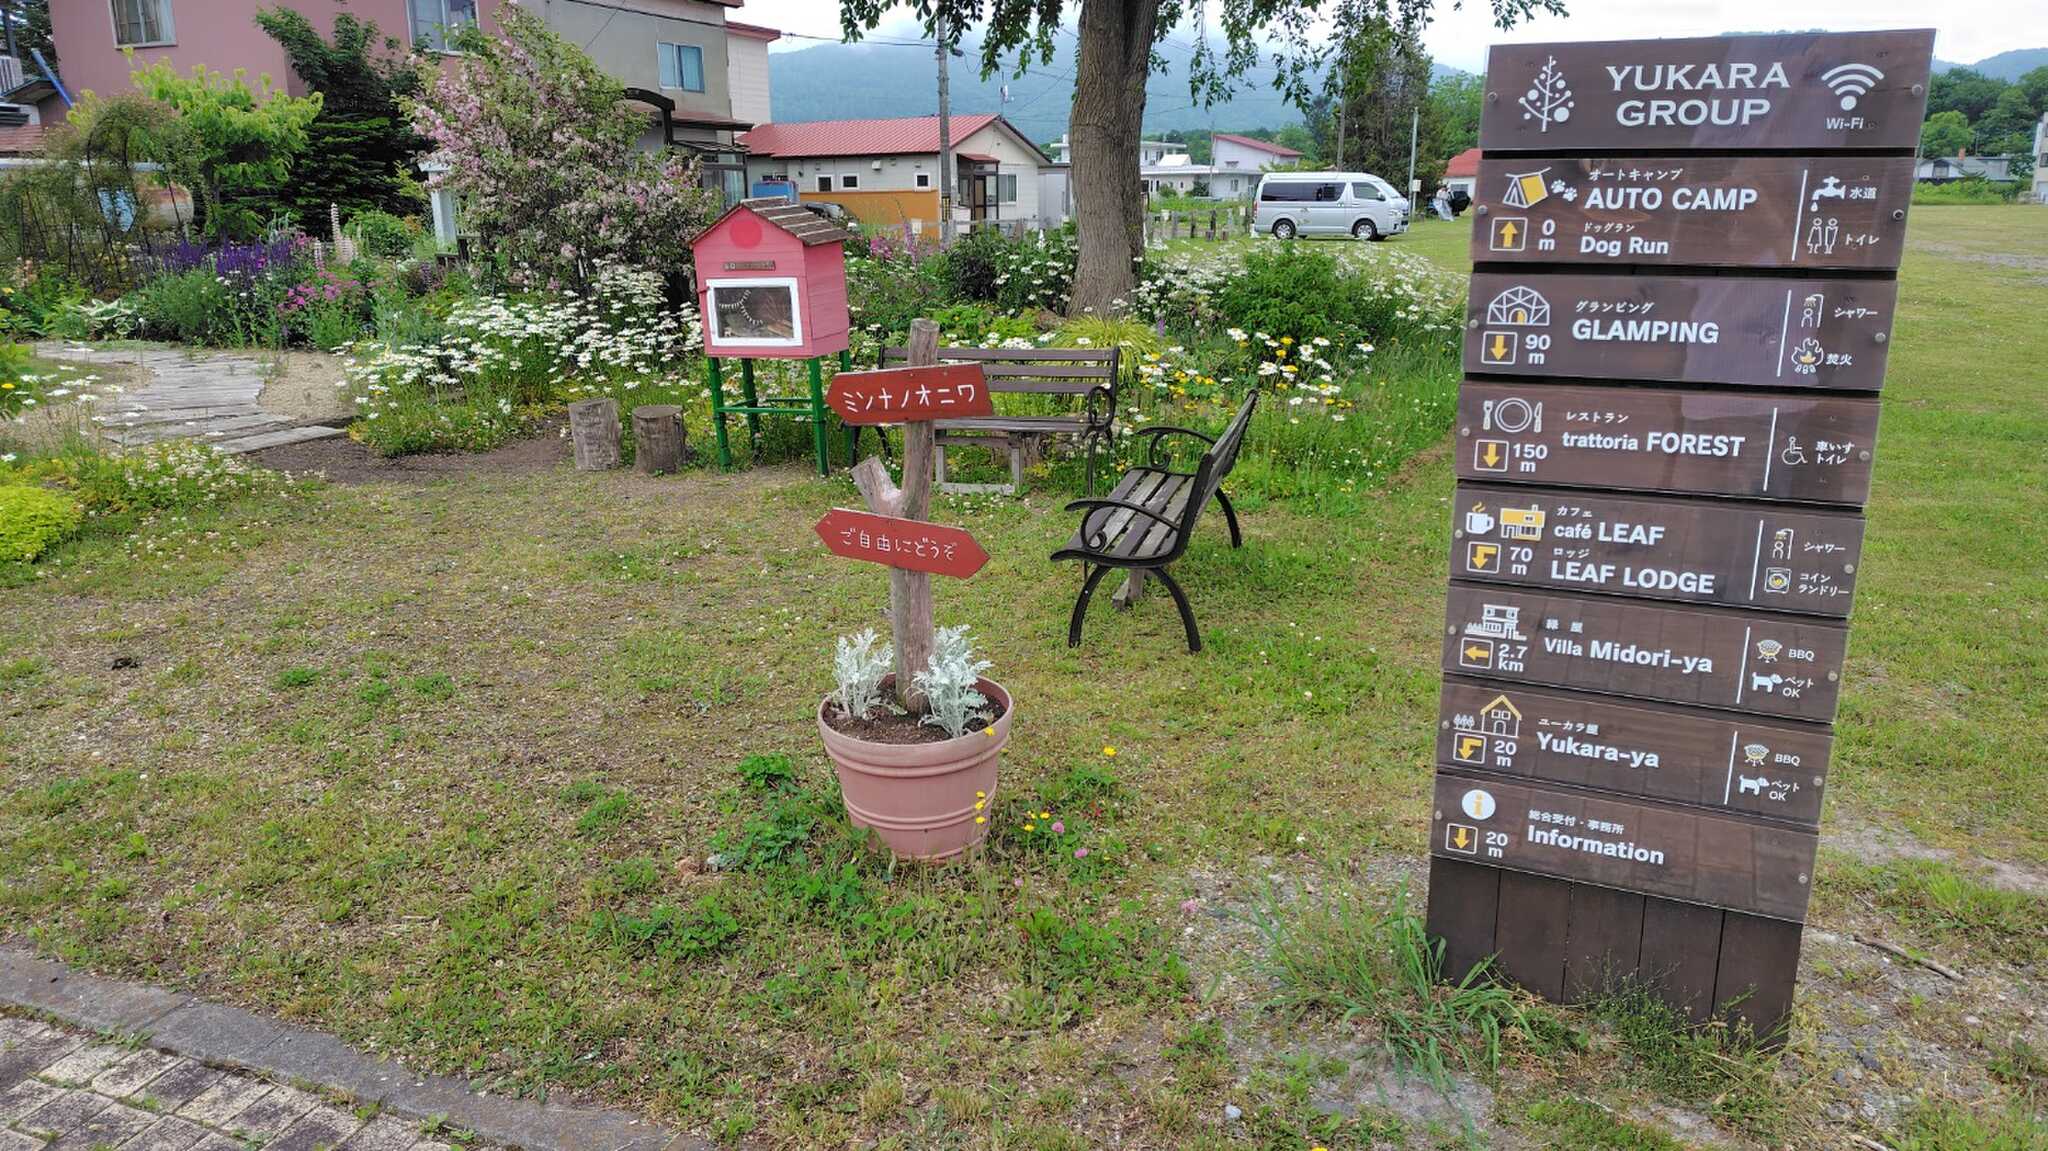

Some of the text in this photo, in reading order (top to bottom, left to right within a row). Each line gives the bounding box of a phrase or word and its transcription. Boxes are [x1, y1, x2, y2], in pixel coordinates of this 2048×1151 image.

[1604, 61, 1791, 92] YUKARA
[1615, 98, 1772, 128] GROUP
[1825, 116, 1864, 131] Wi-Fi
[1588, 167, 1685, 181] オートキャンプ
[1583, 188, 1759, 212] AUTO CAMP
[1849, 185, 1878, 200] 水道
[1582, 221, 1636, 234] ドッグラン
[1538, 236, 1556, 252] m
[1579, 234, 1670, 258] Dog Run
[1844, 232, 1880, 247] トイレ
[1574, 299, 1656, 315] グランピング
[1833, 305, 1880, 319] シャワー
[1572, 317, 1720, 345] GLAMPING
[1524, 332, 1552, 352] 90
[1527, 351, 1546, 366] m
[1825, 351, 1853, 367] 焚火
[842, 383, 976, 413] ミンナノオニワ
[1565, 410, 1629, 425] レストラン
[1512, 442, 1549, 460] 150
[1562, 430, 1746, 458] trattoria FOREST
[1519, 459, 1537, 474] m
[1815, 451, 1847, 467] トイレ
[1556, 505, 1594, 518] カフェ
[1554, 521, 1666, 547] café LEAF
[839, 526, 958, 560] ご自由にどうぞ
[1803, 541, 1847, 554] シャワー
[1509, 546, 1534, 563] 70
[1552, 547, 1591, 560] ロッジ
[1510, 562, 1529, 577] m
[1798, 571, 1832, 584] コイン
[1550, 561, 1716, 595] LEAF LODGE
[1797, 583, 1850, 597] ランドリー
[1497, 642, 1529, 659] 2.7
[1543, 636, 1713, 675] Villa Midori-ya
[1787, 648, 1815, 663] BBQ
[1497, 656, 1524, 673] km
[1784, 675, 1815, 689] ペット
[1781, 686, 1801, 699] OK
[1493, 739, 1518, 756] 20
[1535, 731, 1661, 770] Yukara-ya
[1495, 754, 1513, 769] m
[1774, 754, 1801, 767] BBQ
[1771, 779, 1801, 792] ペット
[1768, 790, 1787, 801] OK
[1485, 831, 1509, 847] 20
[1527, 824, 1666, 866] Information
[1487, 845, 1504, 859] m
